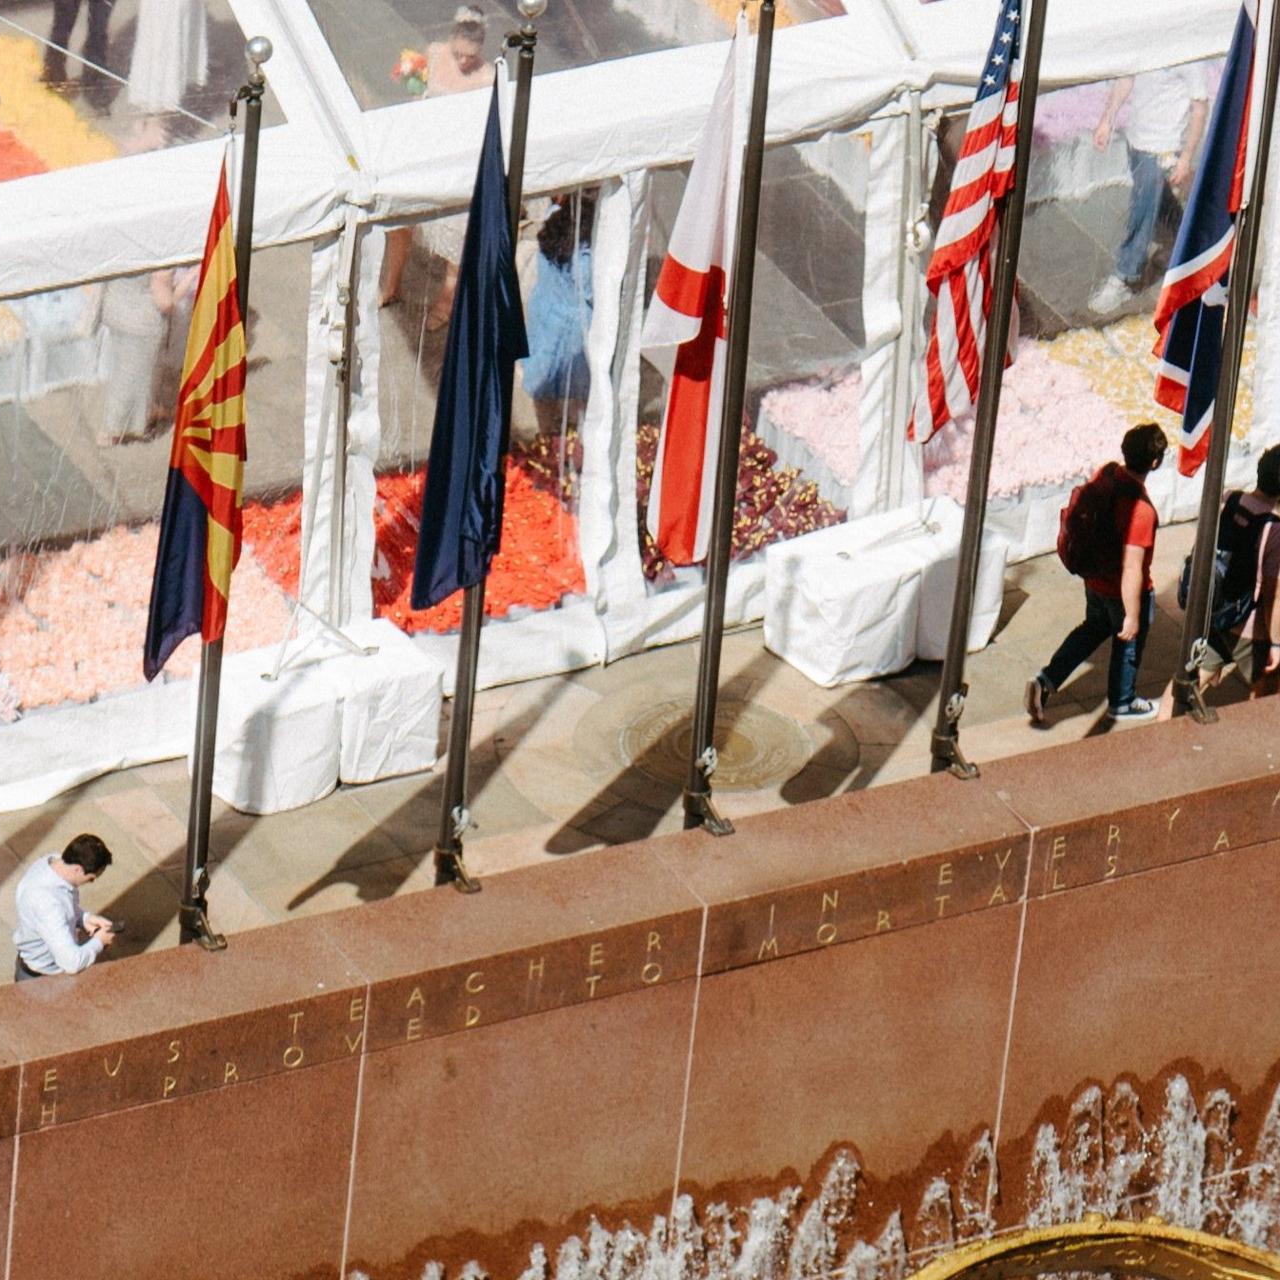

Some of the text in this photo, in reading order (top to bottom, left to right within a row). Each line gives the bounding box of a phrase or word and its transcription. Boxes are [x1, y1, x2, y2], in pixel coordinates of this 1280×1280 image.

[162, 1005, 482, 1098] PROVED
[585, 962, 662, 998] TO
[757, 855, 1120, 959] MORTALS
[287, 931, 662, 1035] TEACHER
[770, 890, 839, 929] IN
[937, 807, 1180, 885] EVERY
